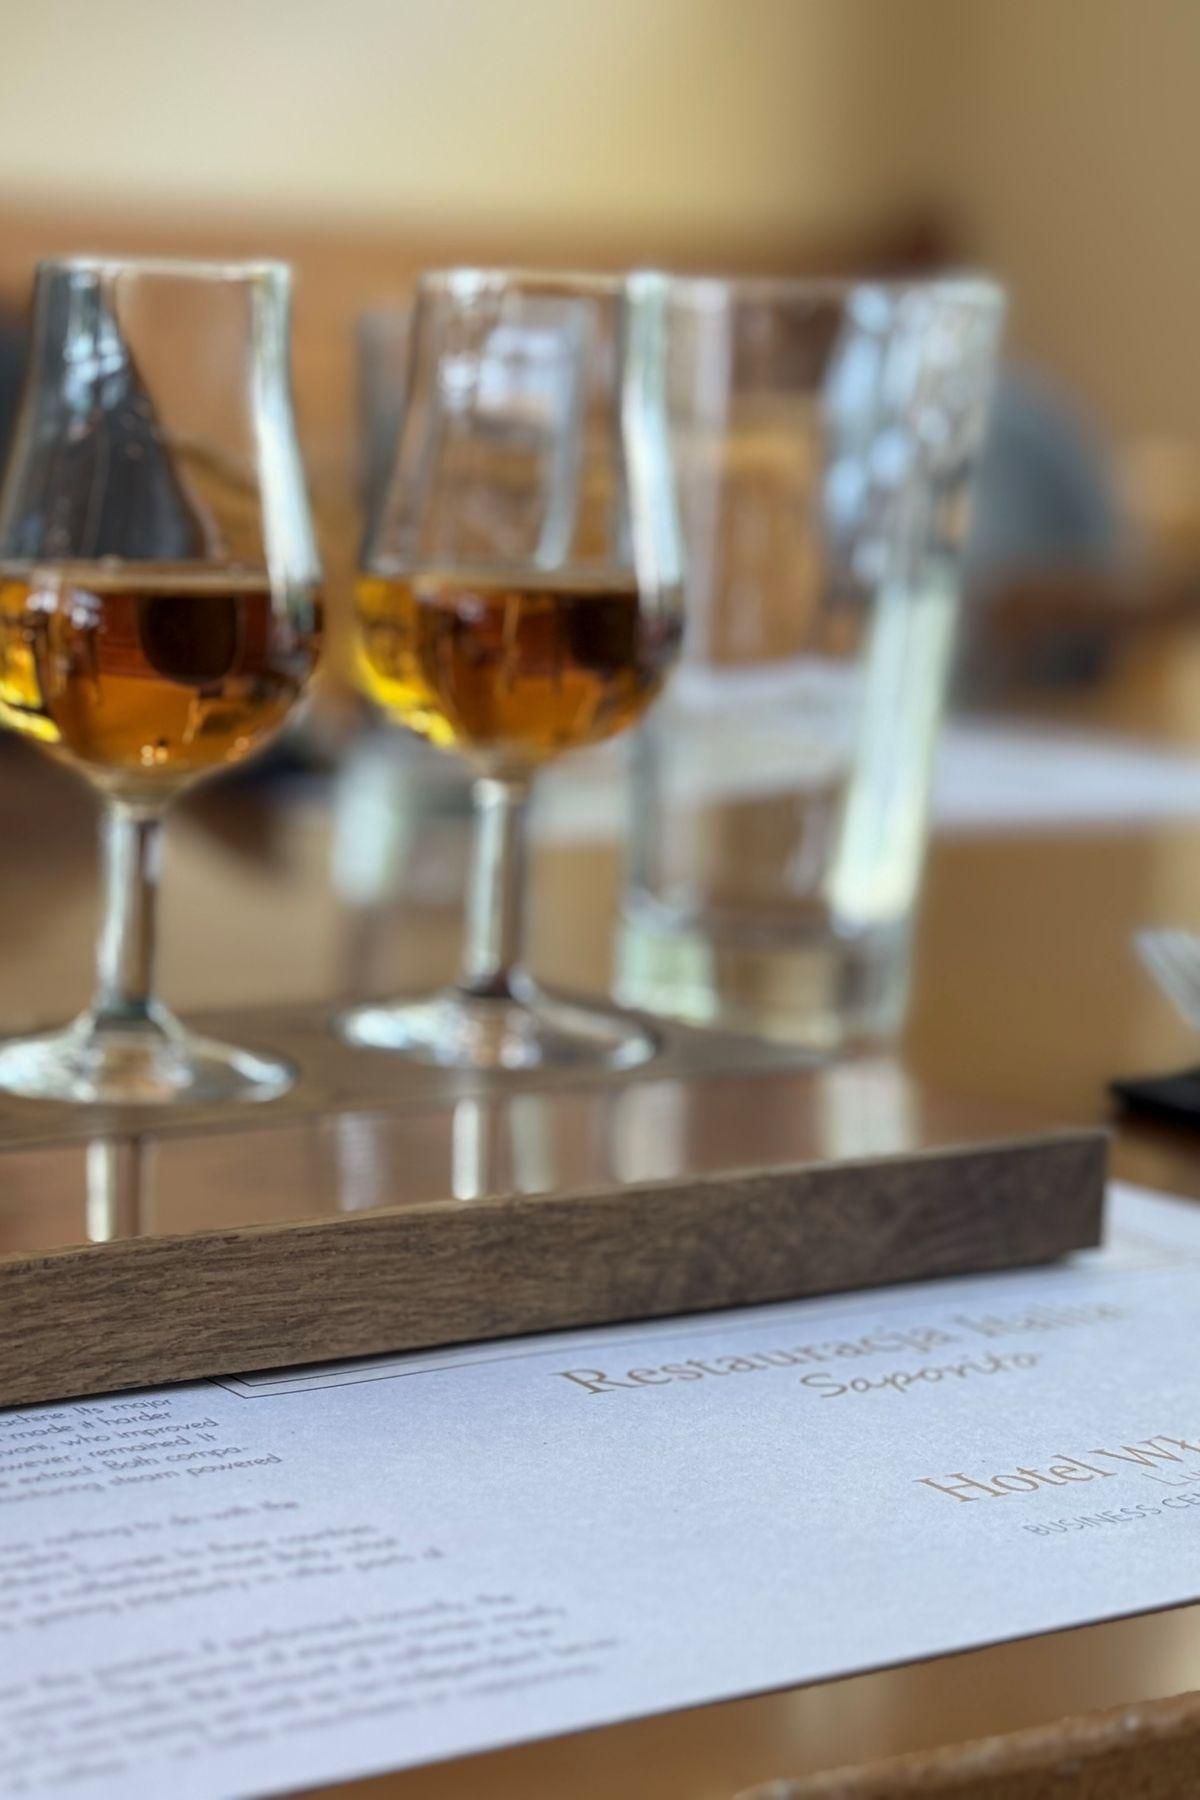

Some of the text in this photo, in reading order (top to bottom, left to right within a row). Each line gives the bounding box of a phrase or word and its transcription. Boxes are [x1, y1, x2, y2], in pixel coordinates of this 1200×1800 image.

[548, 1326, 960, 1394] Restauracja
[72, 1406, 104, 1416] Its
[110, 1399, 173, 1412] major
[9, 1423, 75, 1441] made
[80, 1420, 96, 1429] it
[96, 1411, 173, 1426] harder
[60, 1434, 111, 1447] who
[113, 1417, 220, 1438] improved
[101, 1455, 160, 1471] Both
[186, 1453, 283, 1477] powered
[911, 1454, 1118, 1502] Hotel
[1022, 1492, 1200, 1537] BUSINESS CE
